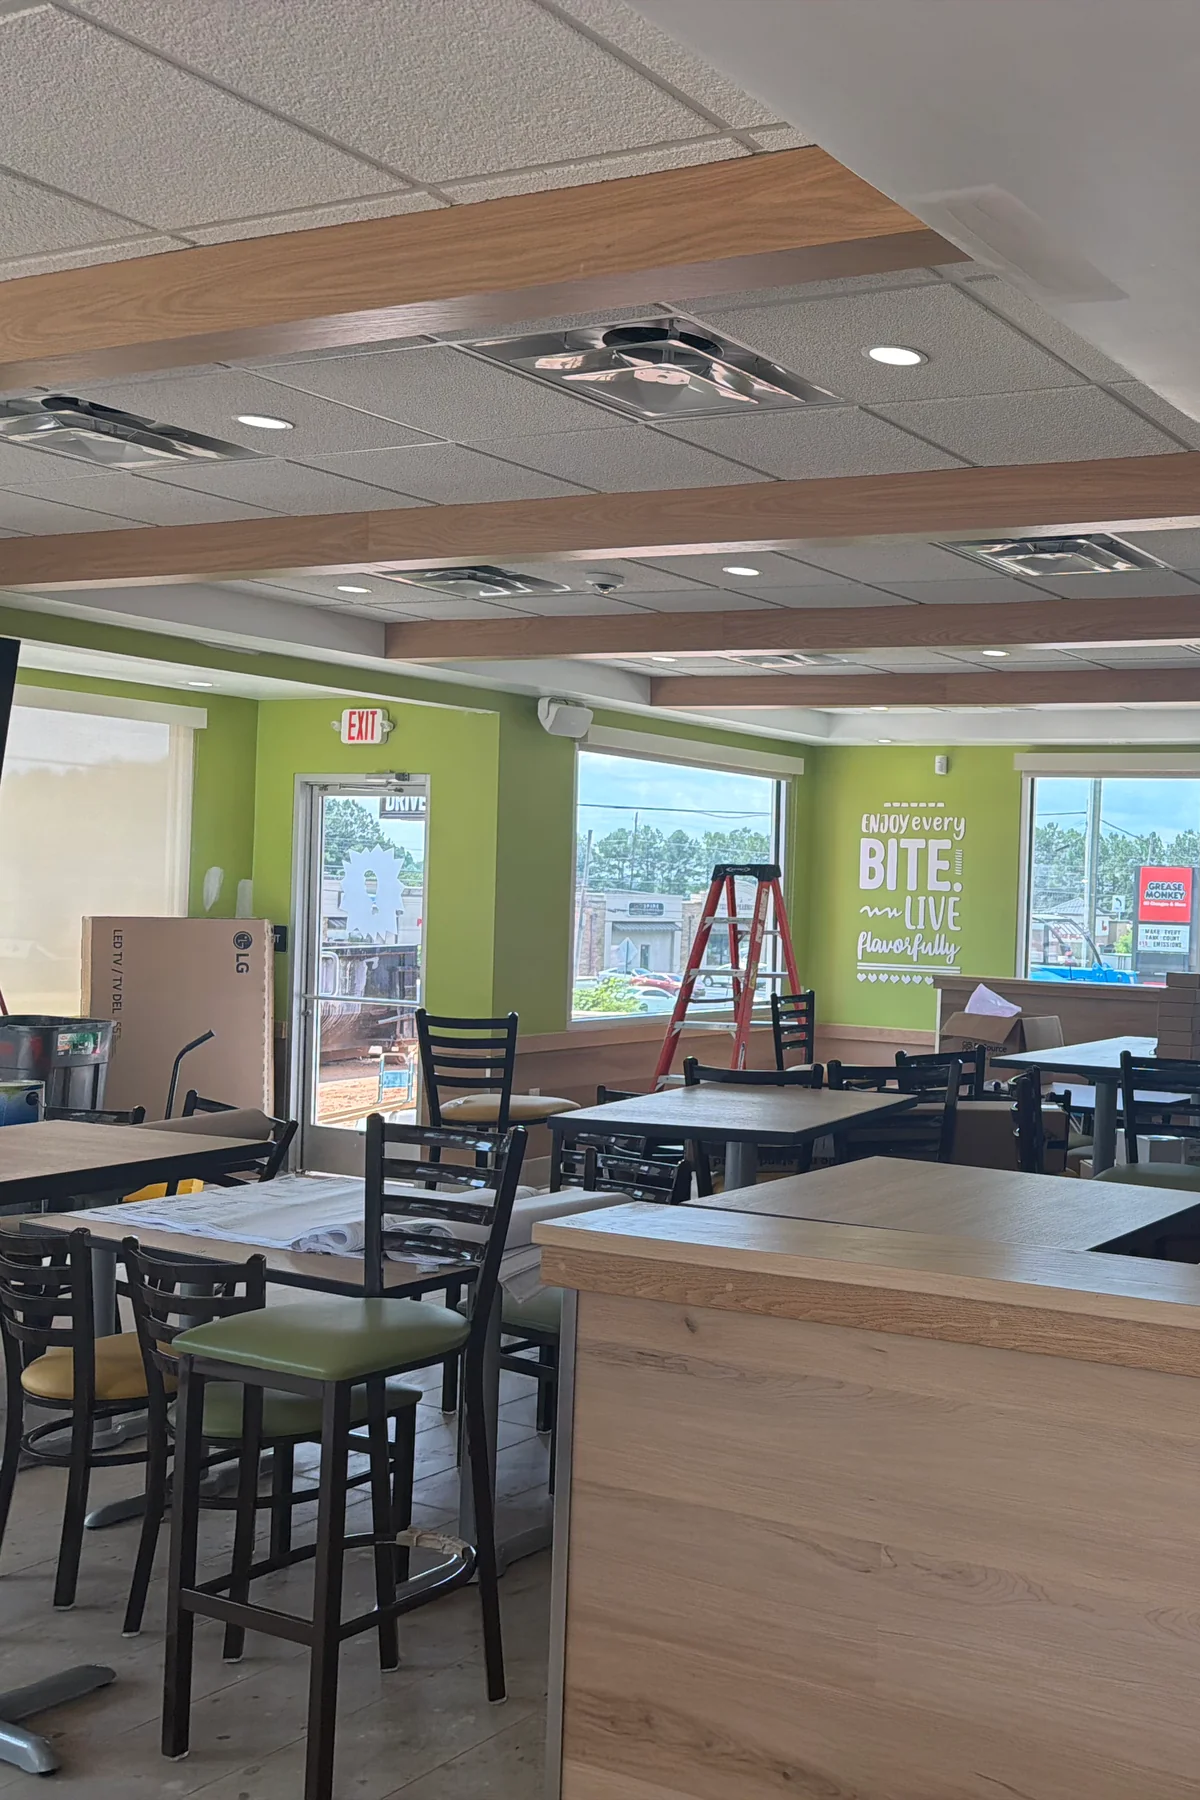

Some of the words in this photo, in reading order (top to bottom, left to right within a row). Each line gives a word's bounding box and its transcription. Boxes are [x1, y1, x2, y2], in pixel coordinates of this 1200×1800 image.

[348, 711, 377, 741] EXIT
[861, 813, 910, 834] ENJOY
[912, 816, 966, 841] every
[859, 837, 963, 892] BITE.
[1145, 891, 1185, 900] MONKEY
[1148, 882, 1183, 891] GREASE
[905, 895, 962, 931] LIVE
[113, 929, 123, 949] LED
[857, 931, 961, 964] flavorfully
[113, 952, 122, 966] TV
[236, 953, 249, 974] LG
[112, 977, 122, 991] TV
[112, 993, 122, 1013] DEL
